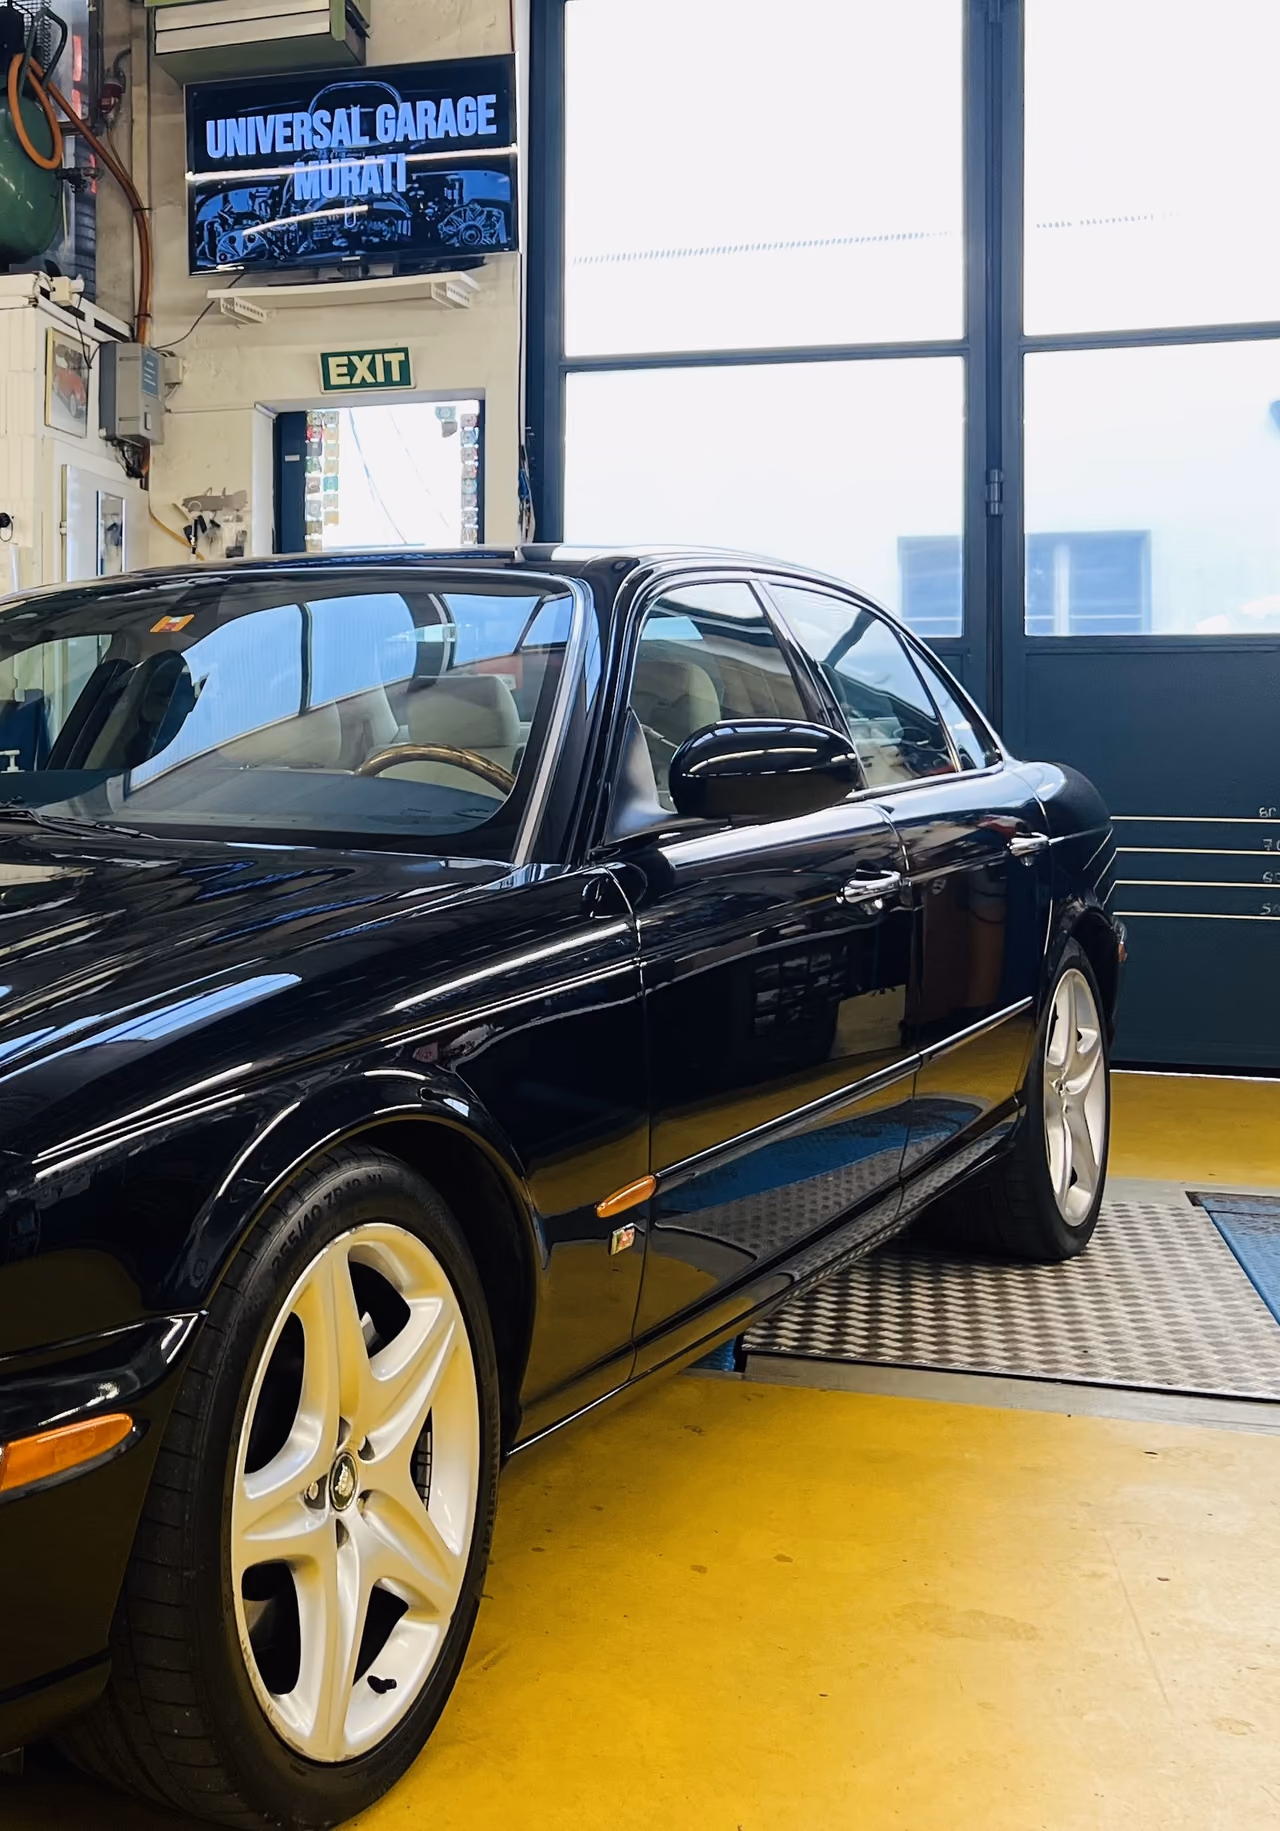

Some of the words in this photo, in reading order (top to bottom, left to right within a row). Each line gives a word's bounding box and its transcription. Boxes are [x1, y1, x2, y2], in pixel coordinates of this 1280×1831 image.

[206, 107, 370, 158] UNIVERSAL
[375, 94, 497, 143] GARAGE
[293, 153, 407, 201] MURATI
[327, 352, 405, 385] EXIT
